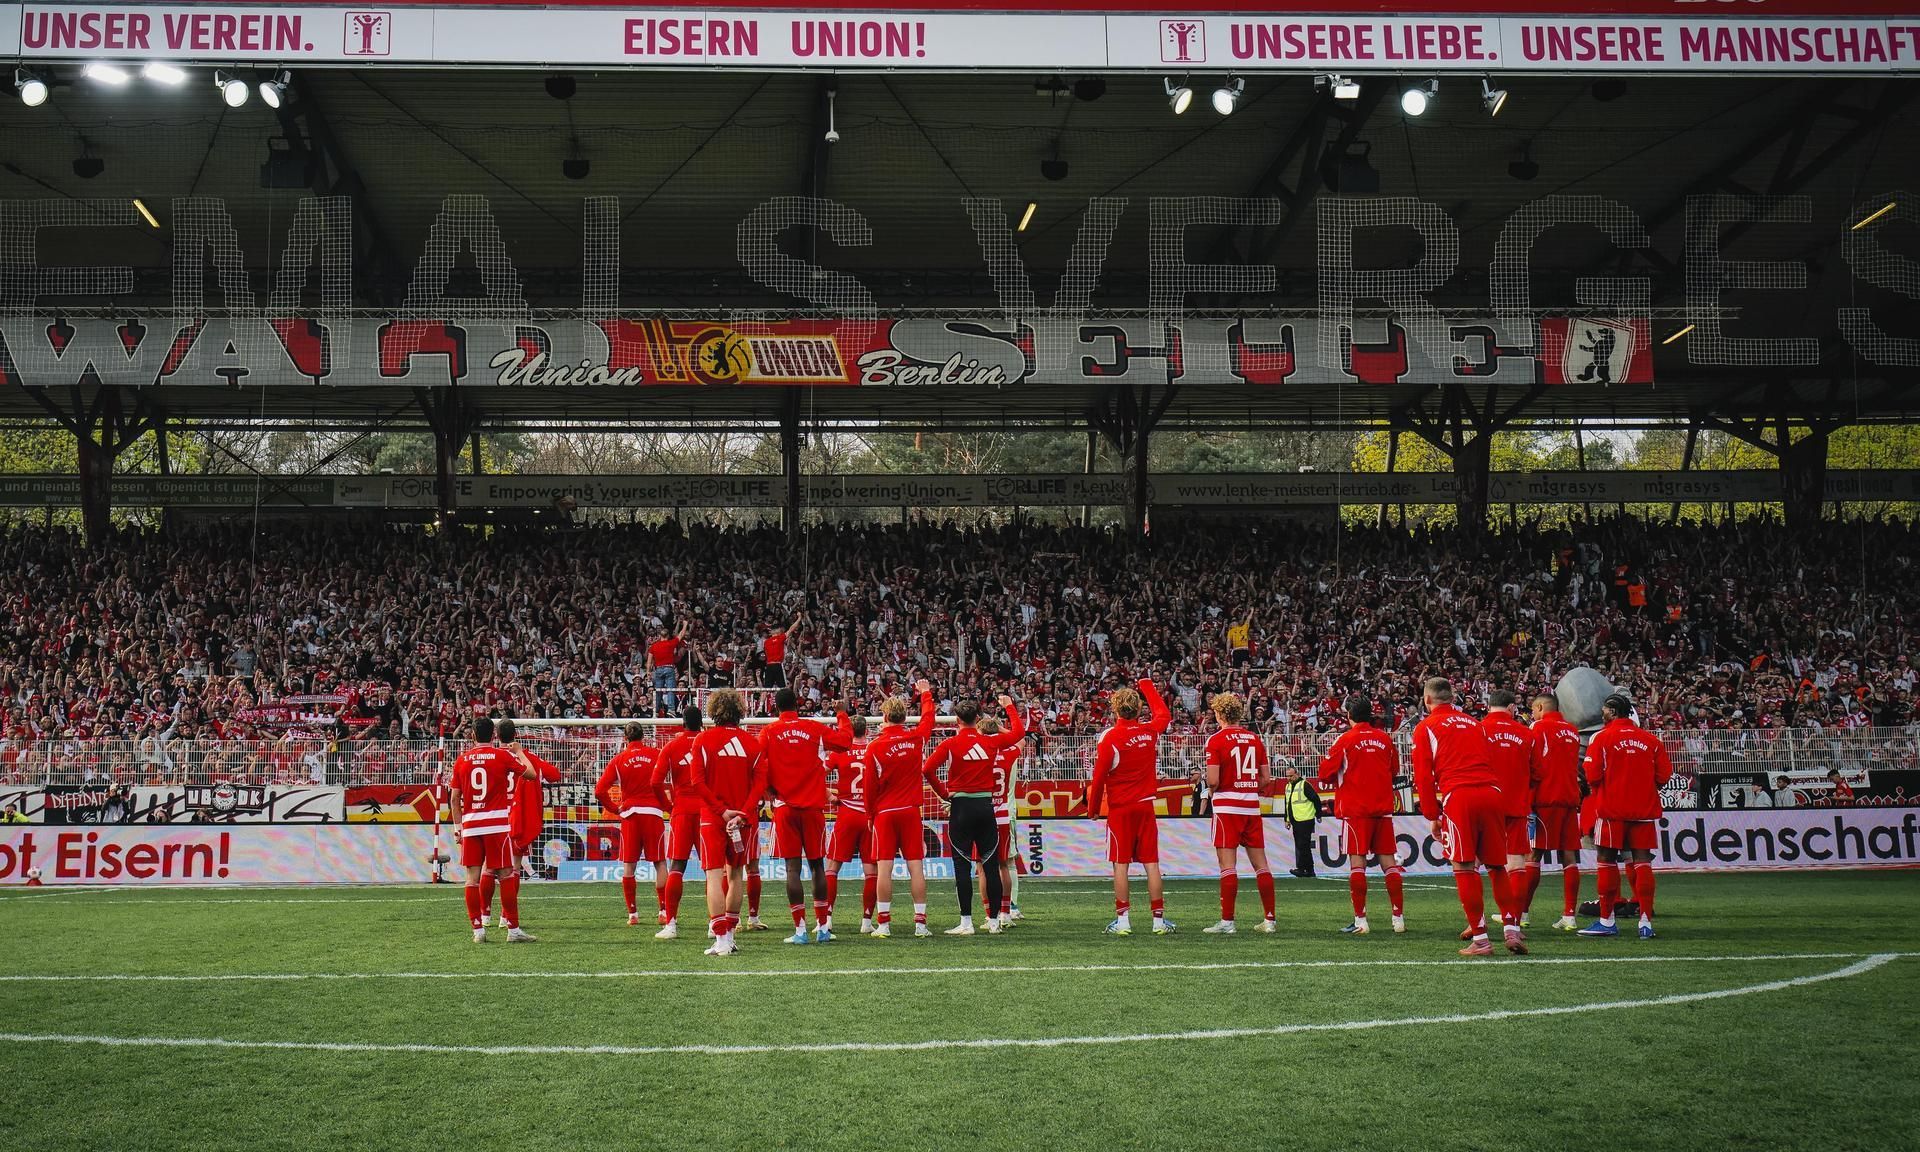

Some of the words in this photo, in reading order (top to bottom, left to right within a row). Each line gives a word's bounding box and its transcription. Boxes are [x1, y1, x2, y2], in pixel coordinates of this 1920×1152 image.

[24, 12, 151, 50] UNSER
[164, 14, 314, 52] VEREIN.
[624, 19, 759, 57] EISERN
[791, 20, 927, 58] UNION!
[1231, 23, 1375, 60] UNSERE
[1385, 24, 1499, 61] LIEBE.
[1522, 25, 1665, 62] UNSERE
[1679, 26, 1920, 63] MANNSCHAFT
[490, 348, 642, 386] Union
[752, 339, 843, 377] UNION
[858, 349, 1006, 386] Berlin
[5, 481, 28, 492] und
[489, 484, 594, 500] Empowering
[1230, 746, 1258, 780] 14
[471, 767, 488, 801] 9
[56, 831, 230, 880] Eisern!
[1029, 823, 1043, 874] GMBH
